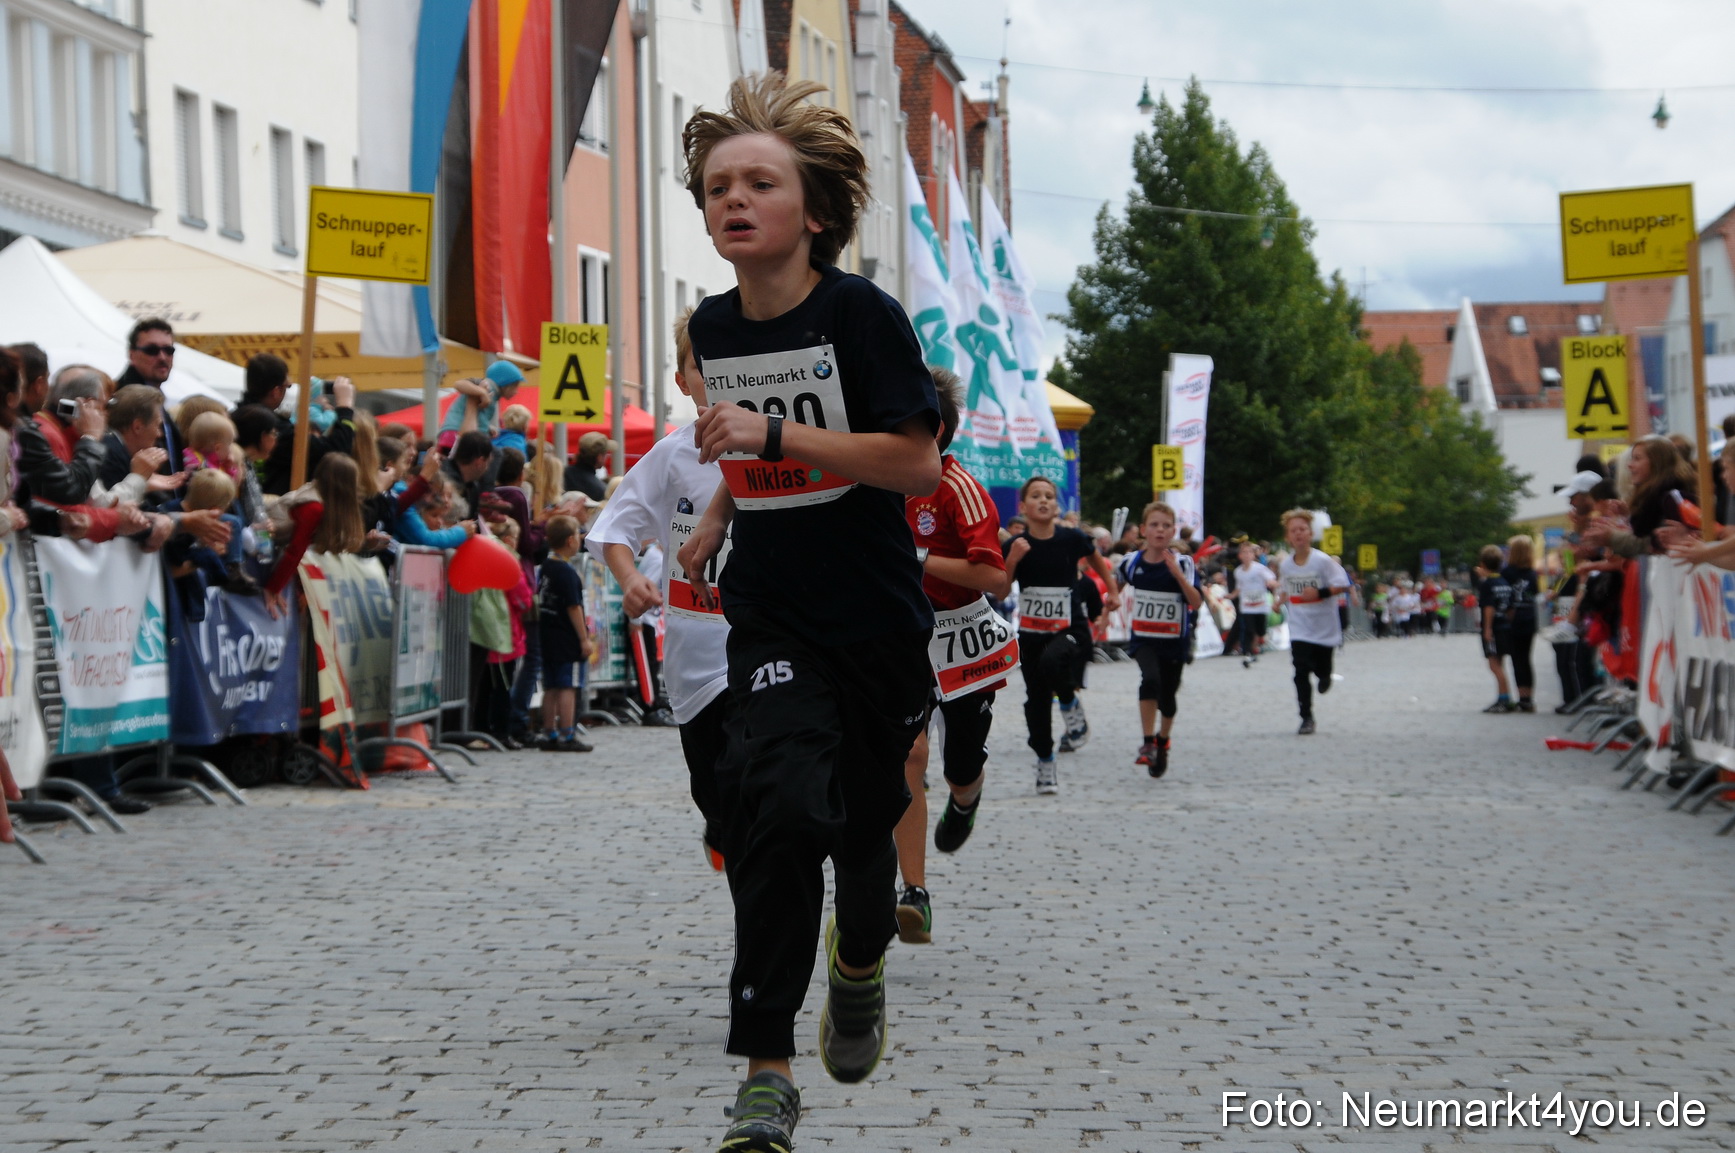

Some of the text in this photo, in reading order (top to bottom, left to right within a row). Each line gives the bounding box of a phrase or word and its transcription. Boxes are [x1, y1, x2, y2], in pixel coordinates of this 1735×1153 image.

[316, 212, 422, 238] Schnupper-
[1570, 213, 1686, 236] Schnupper-
[351, 240, 385, 258] lauf
[1610, 238, 1647, 257] lauf
[548, 326, 600, 345] Block
[1571, 340, 1627, 360] Block
[552, 353, 590, 401] A
[736, 368, 807, 388] Neumarkt
[1581, 367, 1620, 416] A
[744, 466, 807, 492] Niklas
[1162, 459, 1176, 480] B
[1024, 599, 1064, 618] 7204
[1137, 601, 1176, 620] 7079
[750, 660, 793, 691] 215
[963, 657, 1006, 681] Florian
